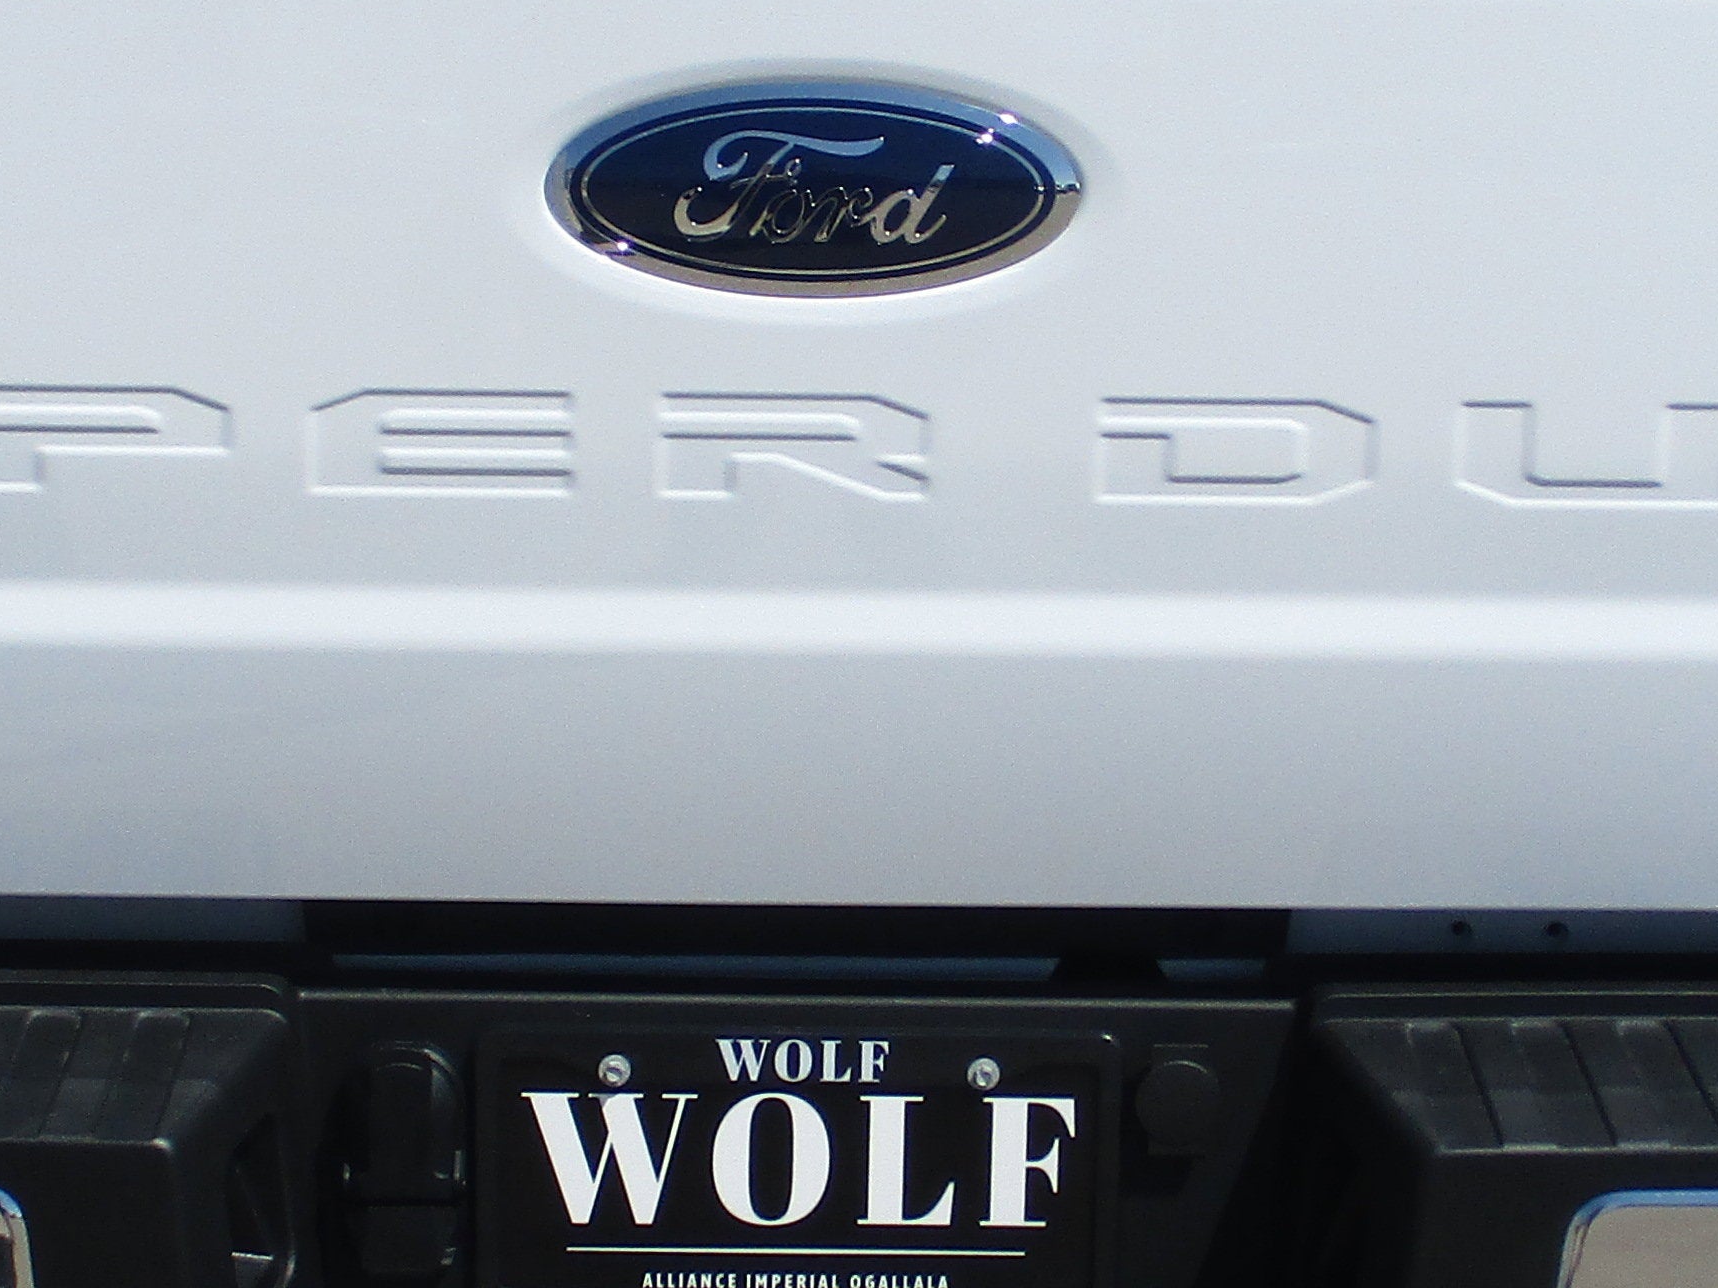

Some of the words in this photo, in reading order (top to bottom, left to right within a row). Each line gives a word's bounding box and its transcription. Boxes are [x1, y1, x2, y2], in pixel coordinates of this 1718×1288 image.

[673, 129, 956, 245] Ford
[715, 1038, 890, 1084] WOLF
[520, 1091, 1076, 1227] WOLF
